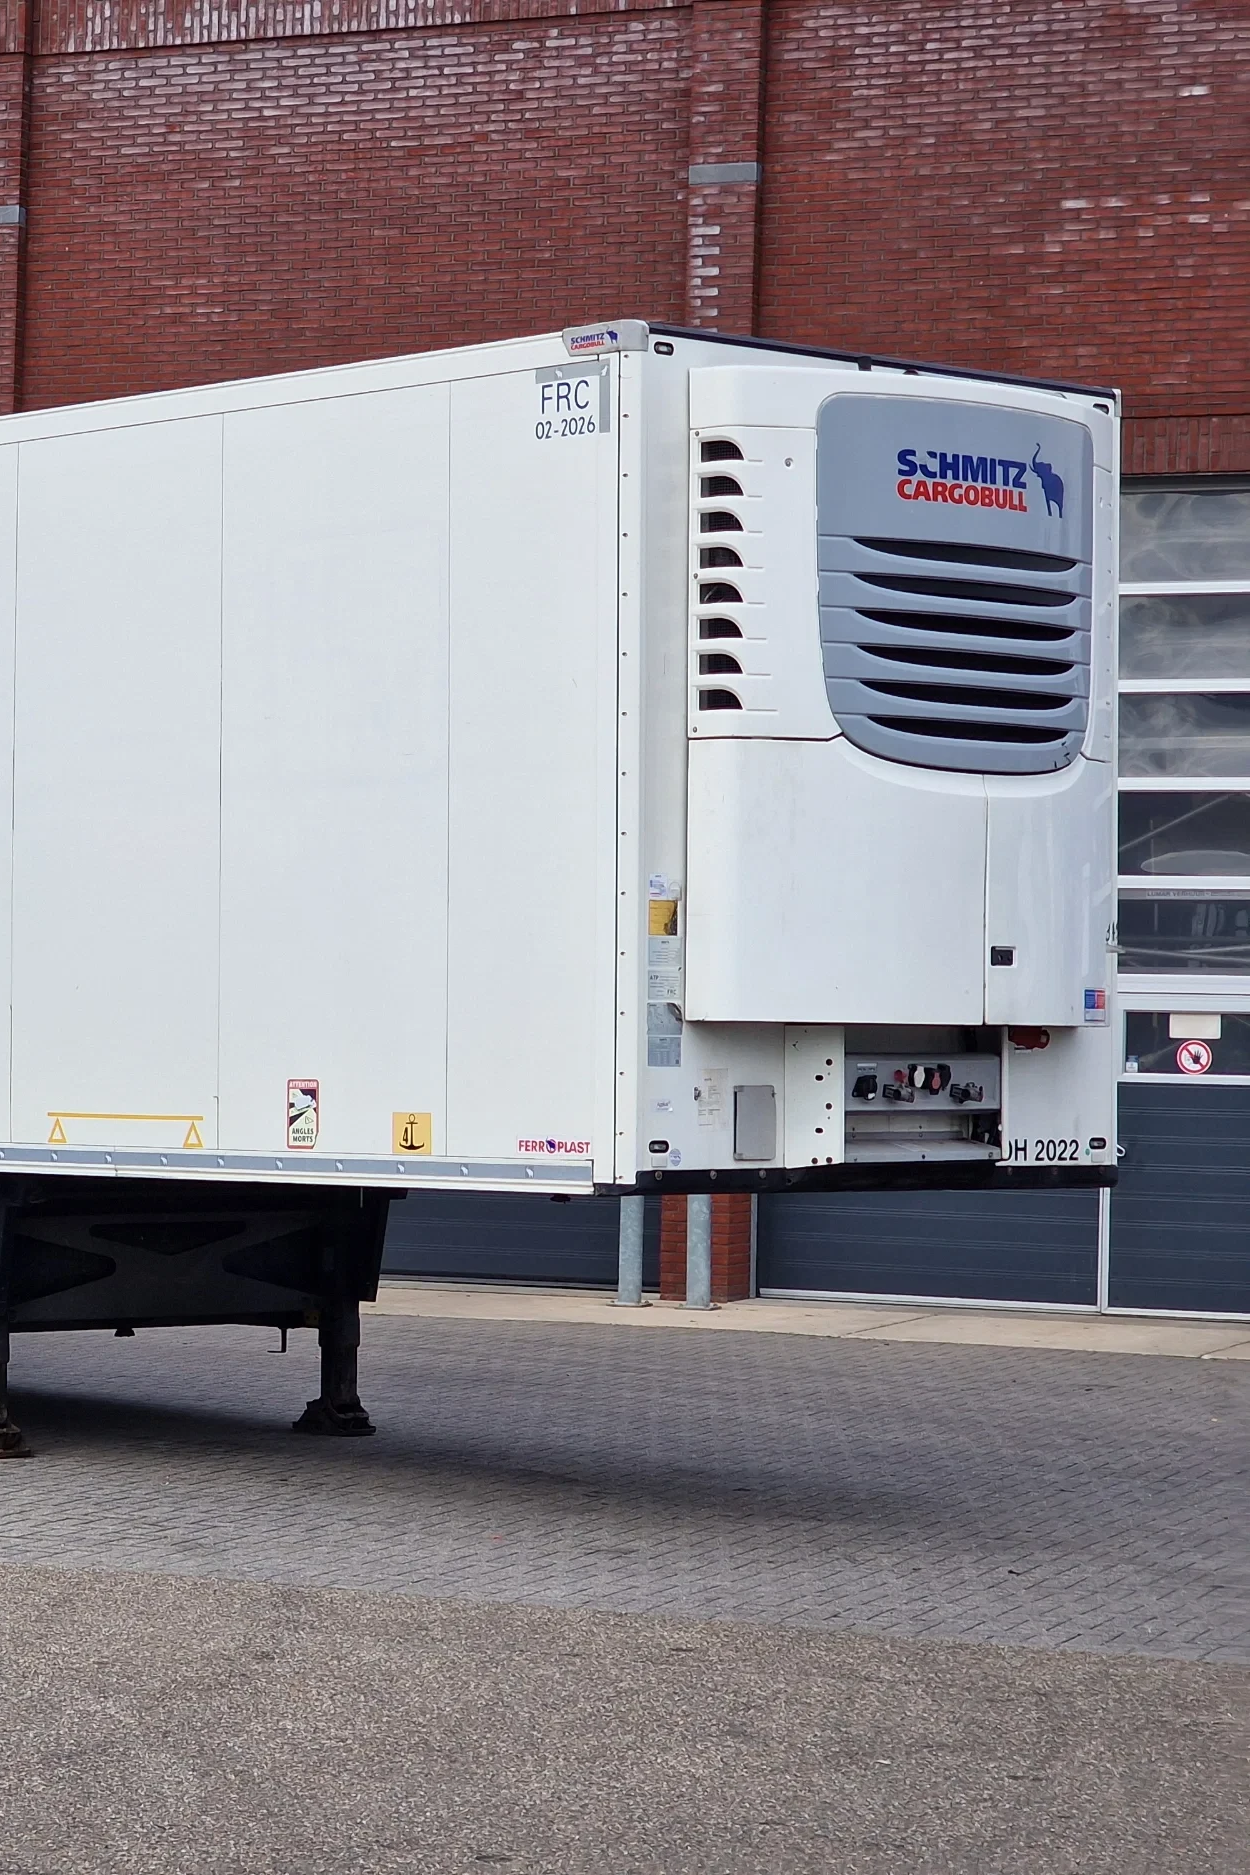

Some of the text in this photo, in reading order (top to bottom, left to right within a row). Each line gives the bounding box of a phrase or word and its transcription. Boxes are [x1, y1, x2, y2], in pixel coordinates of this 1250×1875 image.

[570, 332, 605, 345] SCHMITZ
[570, 340, 605, 351] CARGOBULL
[541, 379, 590, 415] FRC
[535, 415, 596, 440] 02-2026
[897, 449, 1027, 489] SCHMITZ
[897, 478, 1028, 512] CARGOBULL
[292, 1135, 314, 1143] MORTS
[1034, 1139, 1080, 1162] 2022
